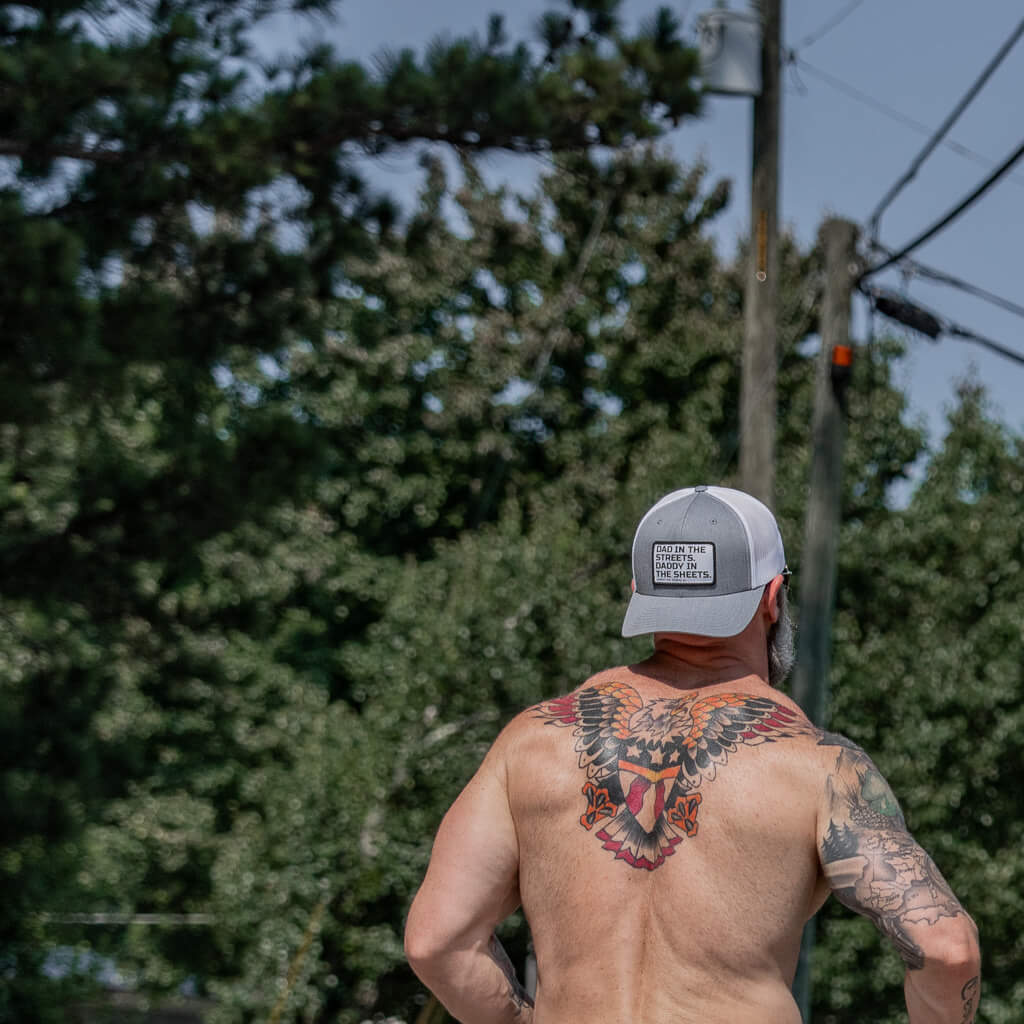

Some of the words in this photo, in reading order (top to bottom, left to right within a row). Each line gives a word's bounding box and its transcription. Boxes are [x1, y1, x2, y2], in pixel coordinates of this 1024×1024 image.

[656, 545, 673, 553] DAD
[675, 545, 685, 553] IN
[688, 546, 706, 554] THE
[655, 554, 696, 562] STREETS.
[655, 562, 684, 570] DADDY
[687, 562, 697, 570] IN
[656, 570, 671, 578] THE
[673, 570, 712, 579] SHEETS.
